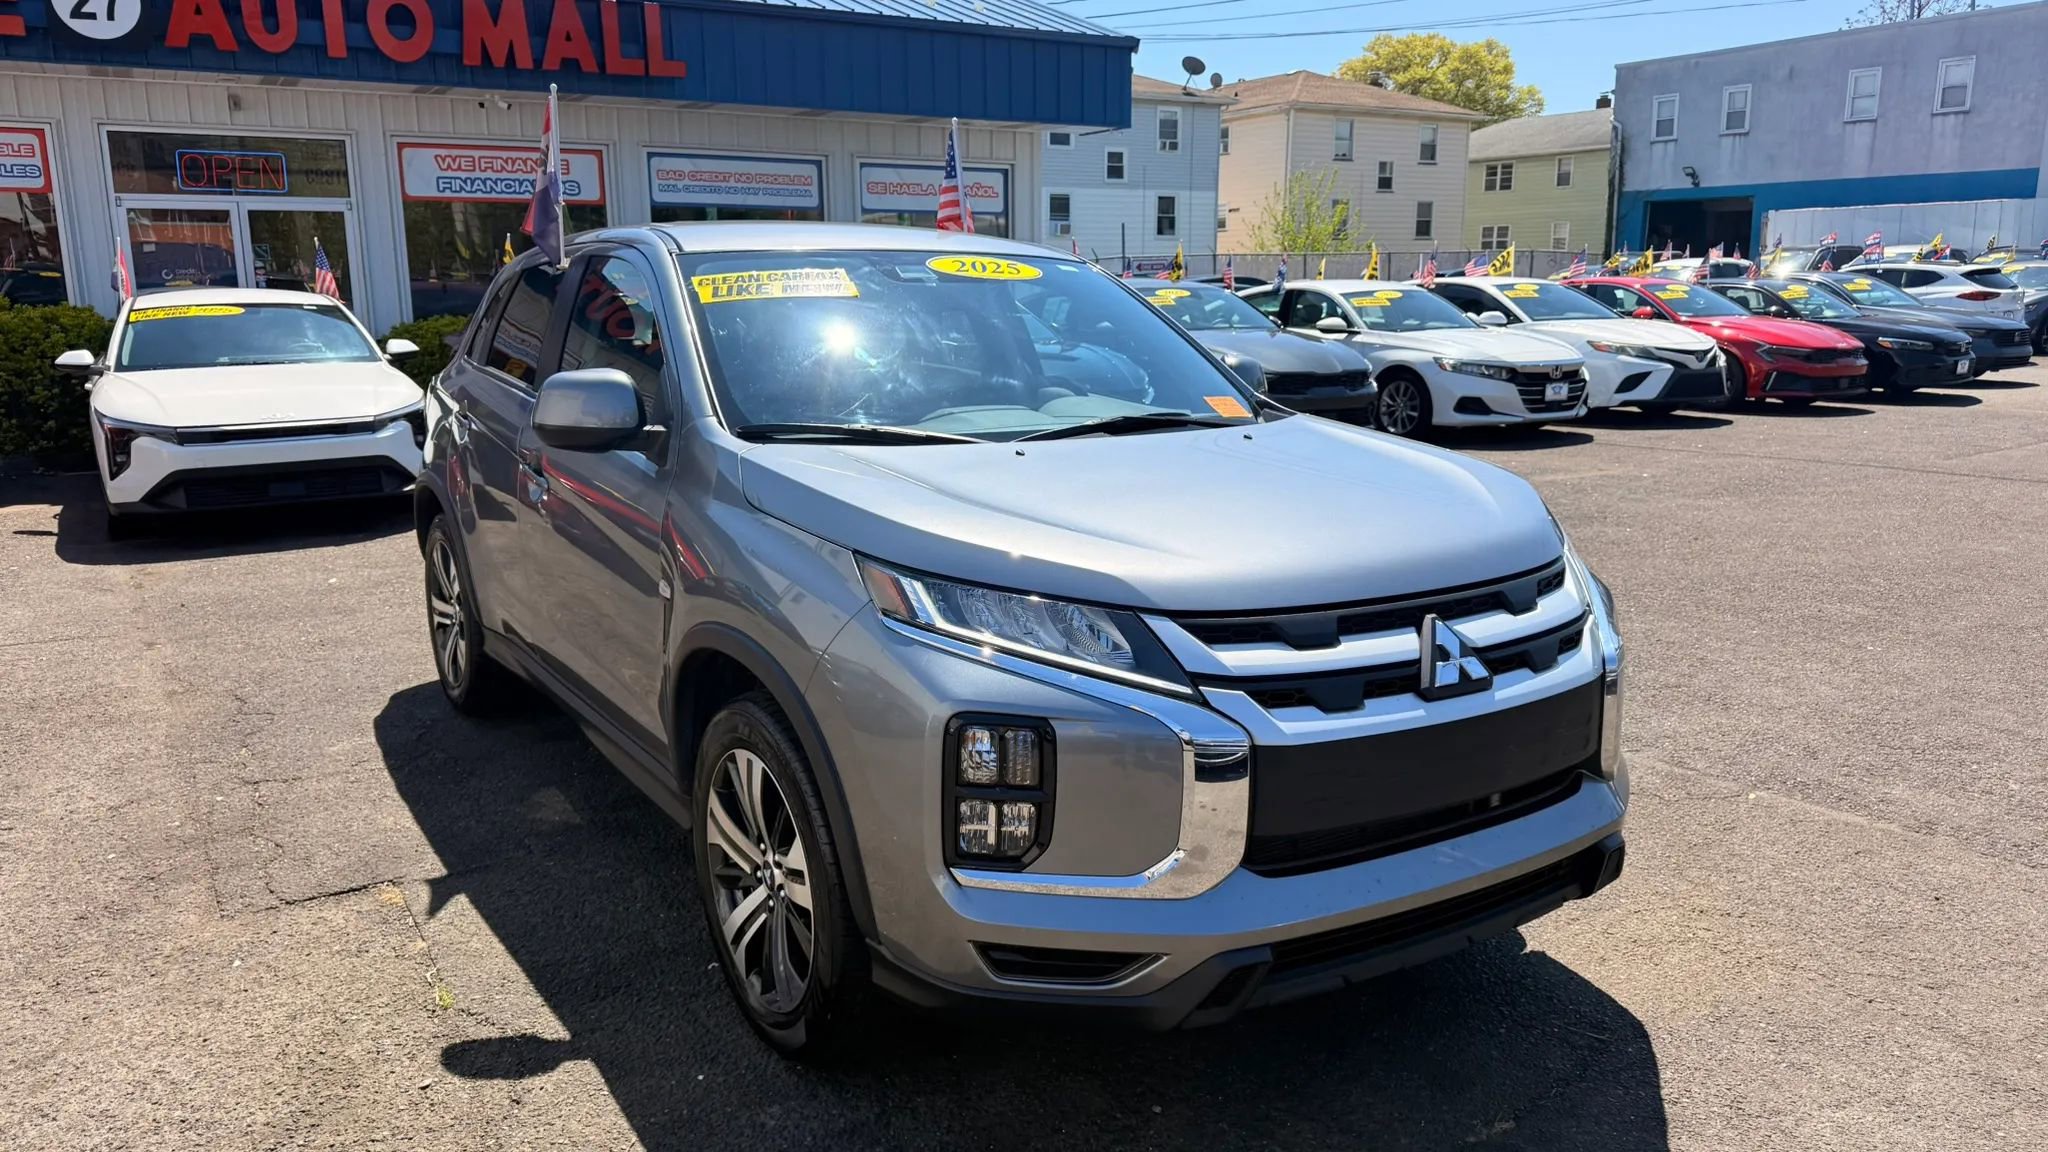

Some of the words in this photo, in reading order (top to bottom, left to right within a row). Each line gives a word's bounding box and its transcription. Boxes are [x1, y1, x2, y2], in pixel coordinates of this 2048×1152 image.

[164, 0, 434, 63] AUTO
[463, 0, 687, 77] MALL
[181, 153, 284, 190] OPEN
[434, 155, 476, 171] WE
[478, 156, 570, 175] FINANE
[657, 169, 686, 181] BAD
[688, 171, 733, 183] CREDIT
[734, 172, 753, 183] NO
[756, 174, 813, 186] PROBLEM
[658, 184, 681, 193] MAL
[682, 185, 723, 194] CREDITO
[724, 187, 740, 195] NO
[741, 187, 762, 195] HAY
[762, 188, 813, 197] PROBLEMA
[867, 181, 888, 195] SE
[889, 182, 937, 196] HABLA
[951, 259, 1021, 275] 2025
[697, 271, 762, 287] CLEAN
[711, 283, 771, 298] LIKE
